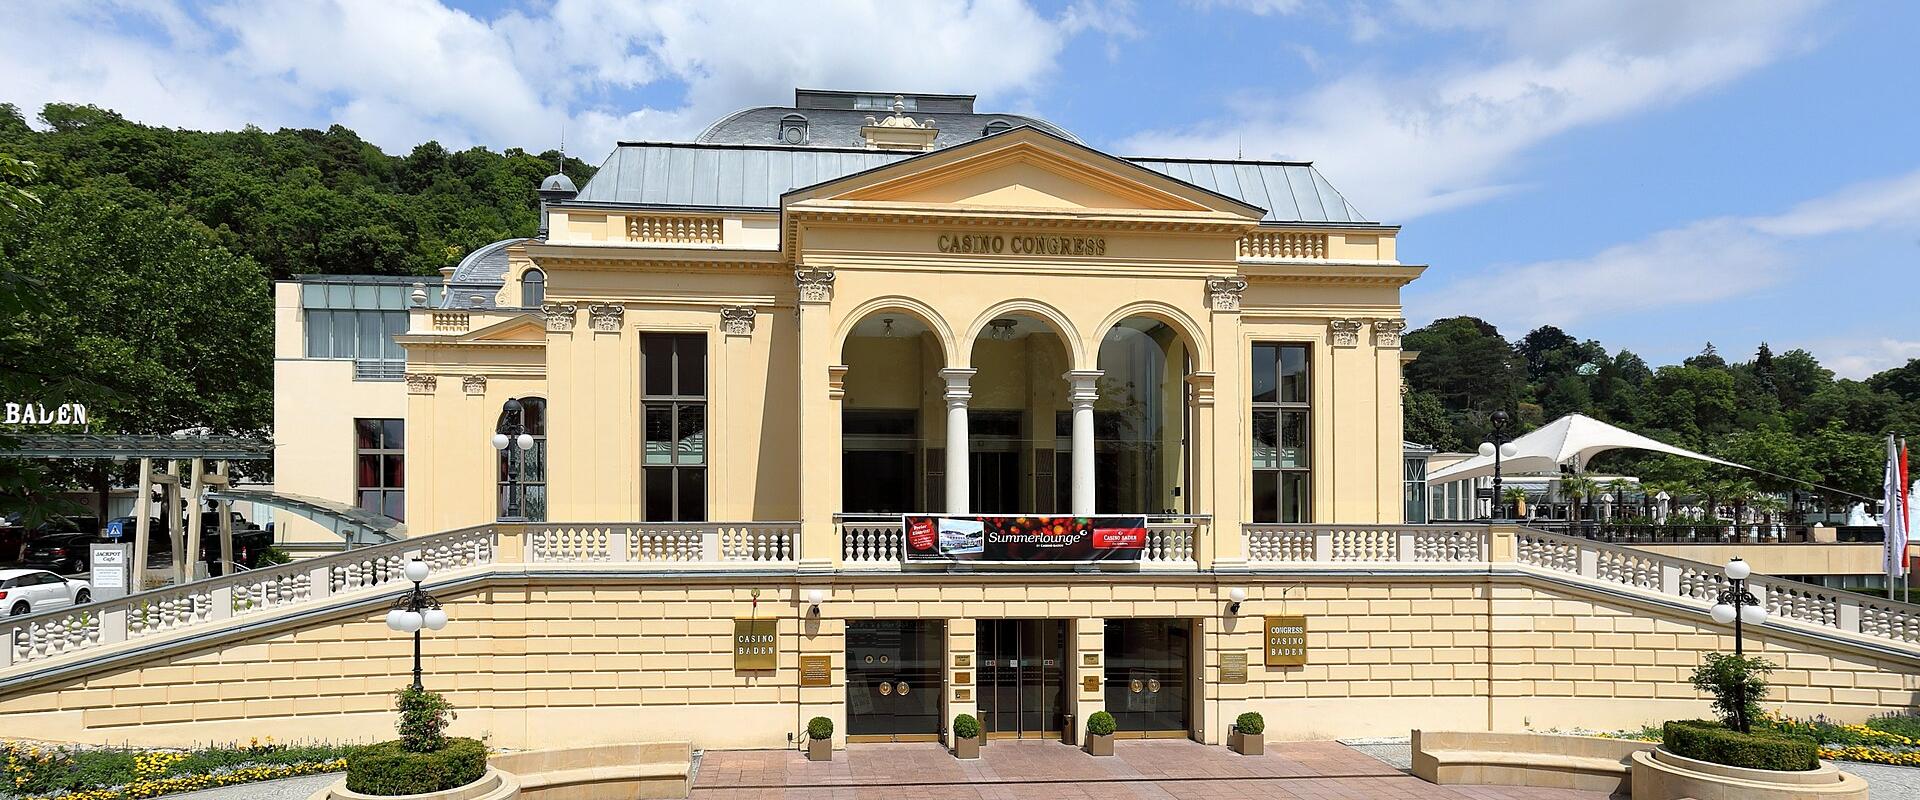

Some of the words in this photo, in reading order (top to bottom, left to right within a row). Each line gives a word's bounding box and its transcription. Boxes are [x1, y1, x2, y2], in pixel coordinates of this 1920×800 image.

[938, 234, 1004, 253] CASINO
[1010, 235, 1106, 255] CONGRESS
[988, 531, 1081, 546] Summerlounge
[1271, 626, 1303, 634] CONGRESS
[738, 635, 774, 643] CASINO
[1271, 637, 1303, 645] CASINO
[738, 647, 774, 655] BADEN
[1271, 648, 1303, 656] BADEN
